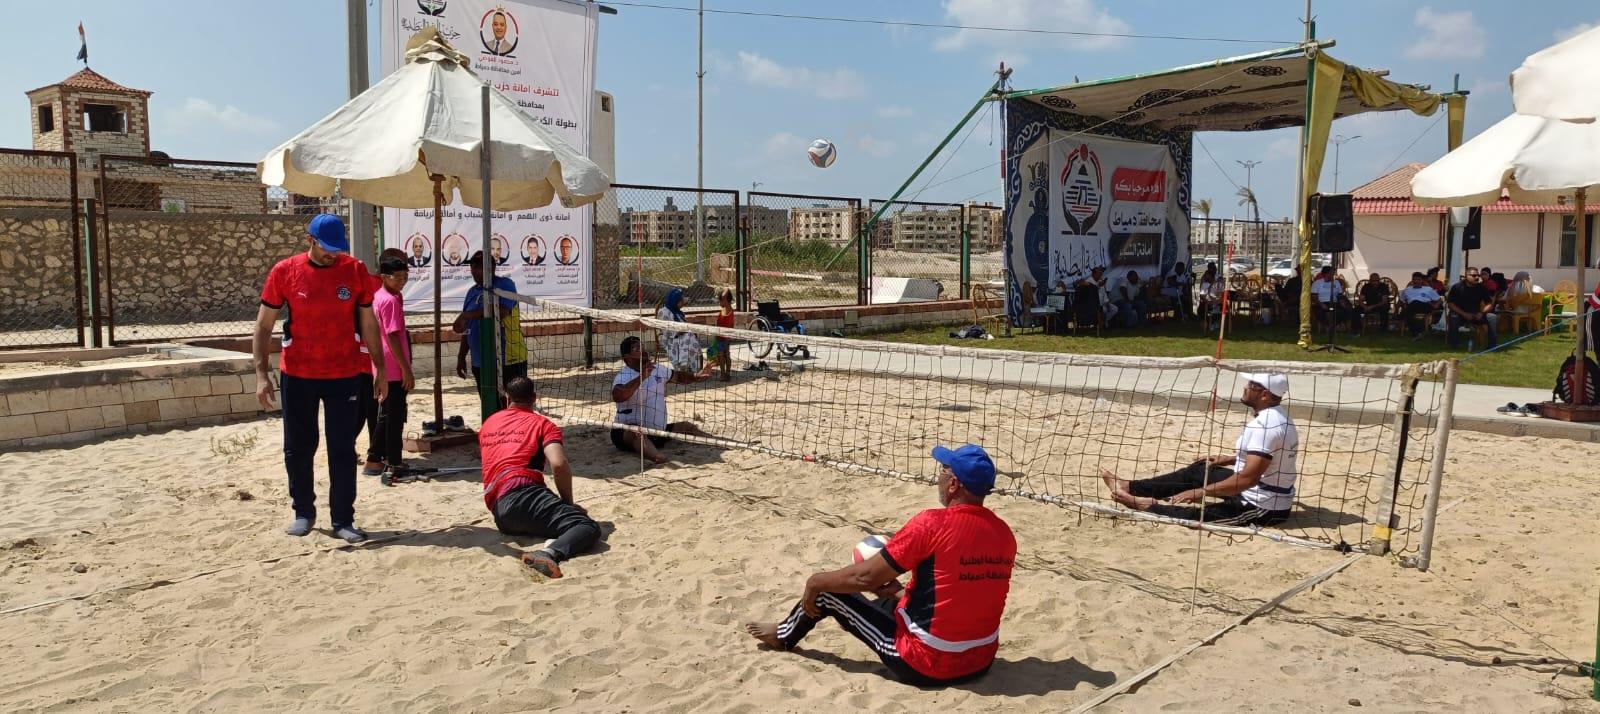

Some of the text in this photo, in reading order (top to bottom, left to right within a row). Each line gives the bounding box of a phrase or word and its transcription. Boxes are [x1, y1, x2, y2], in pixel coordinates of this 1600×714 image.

[475, 63, 490, 72] دمياط
[490, 65, 510, 74] محافظة
[494, 82, 510, 92] حزب
[533, 87, 560, 97] تتشرف
[555, 118, 577, 131] بطولة
[1113, 211, 1138, 231] دمياط
